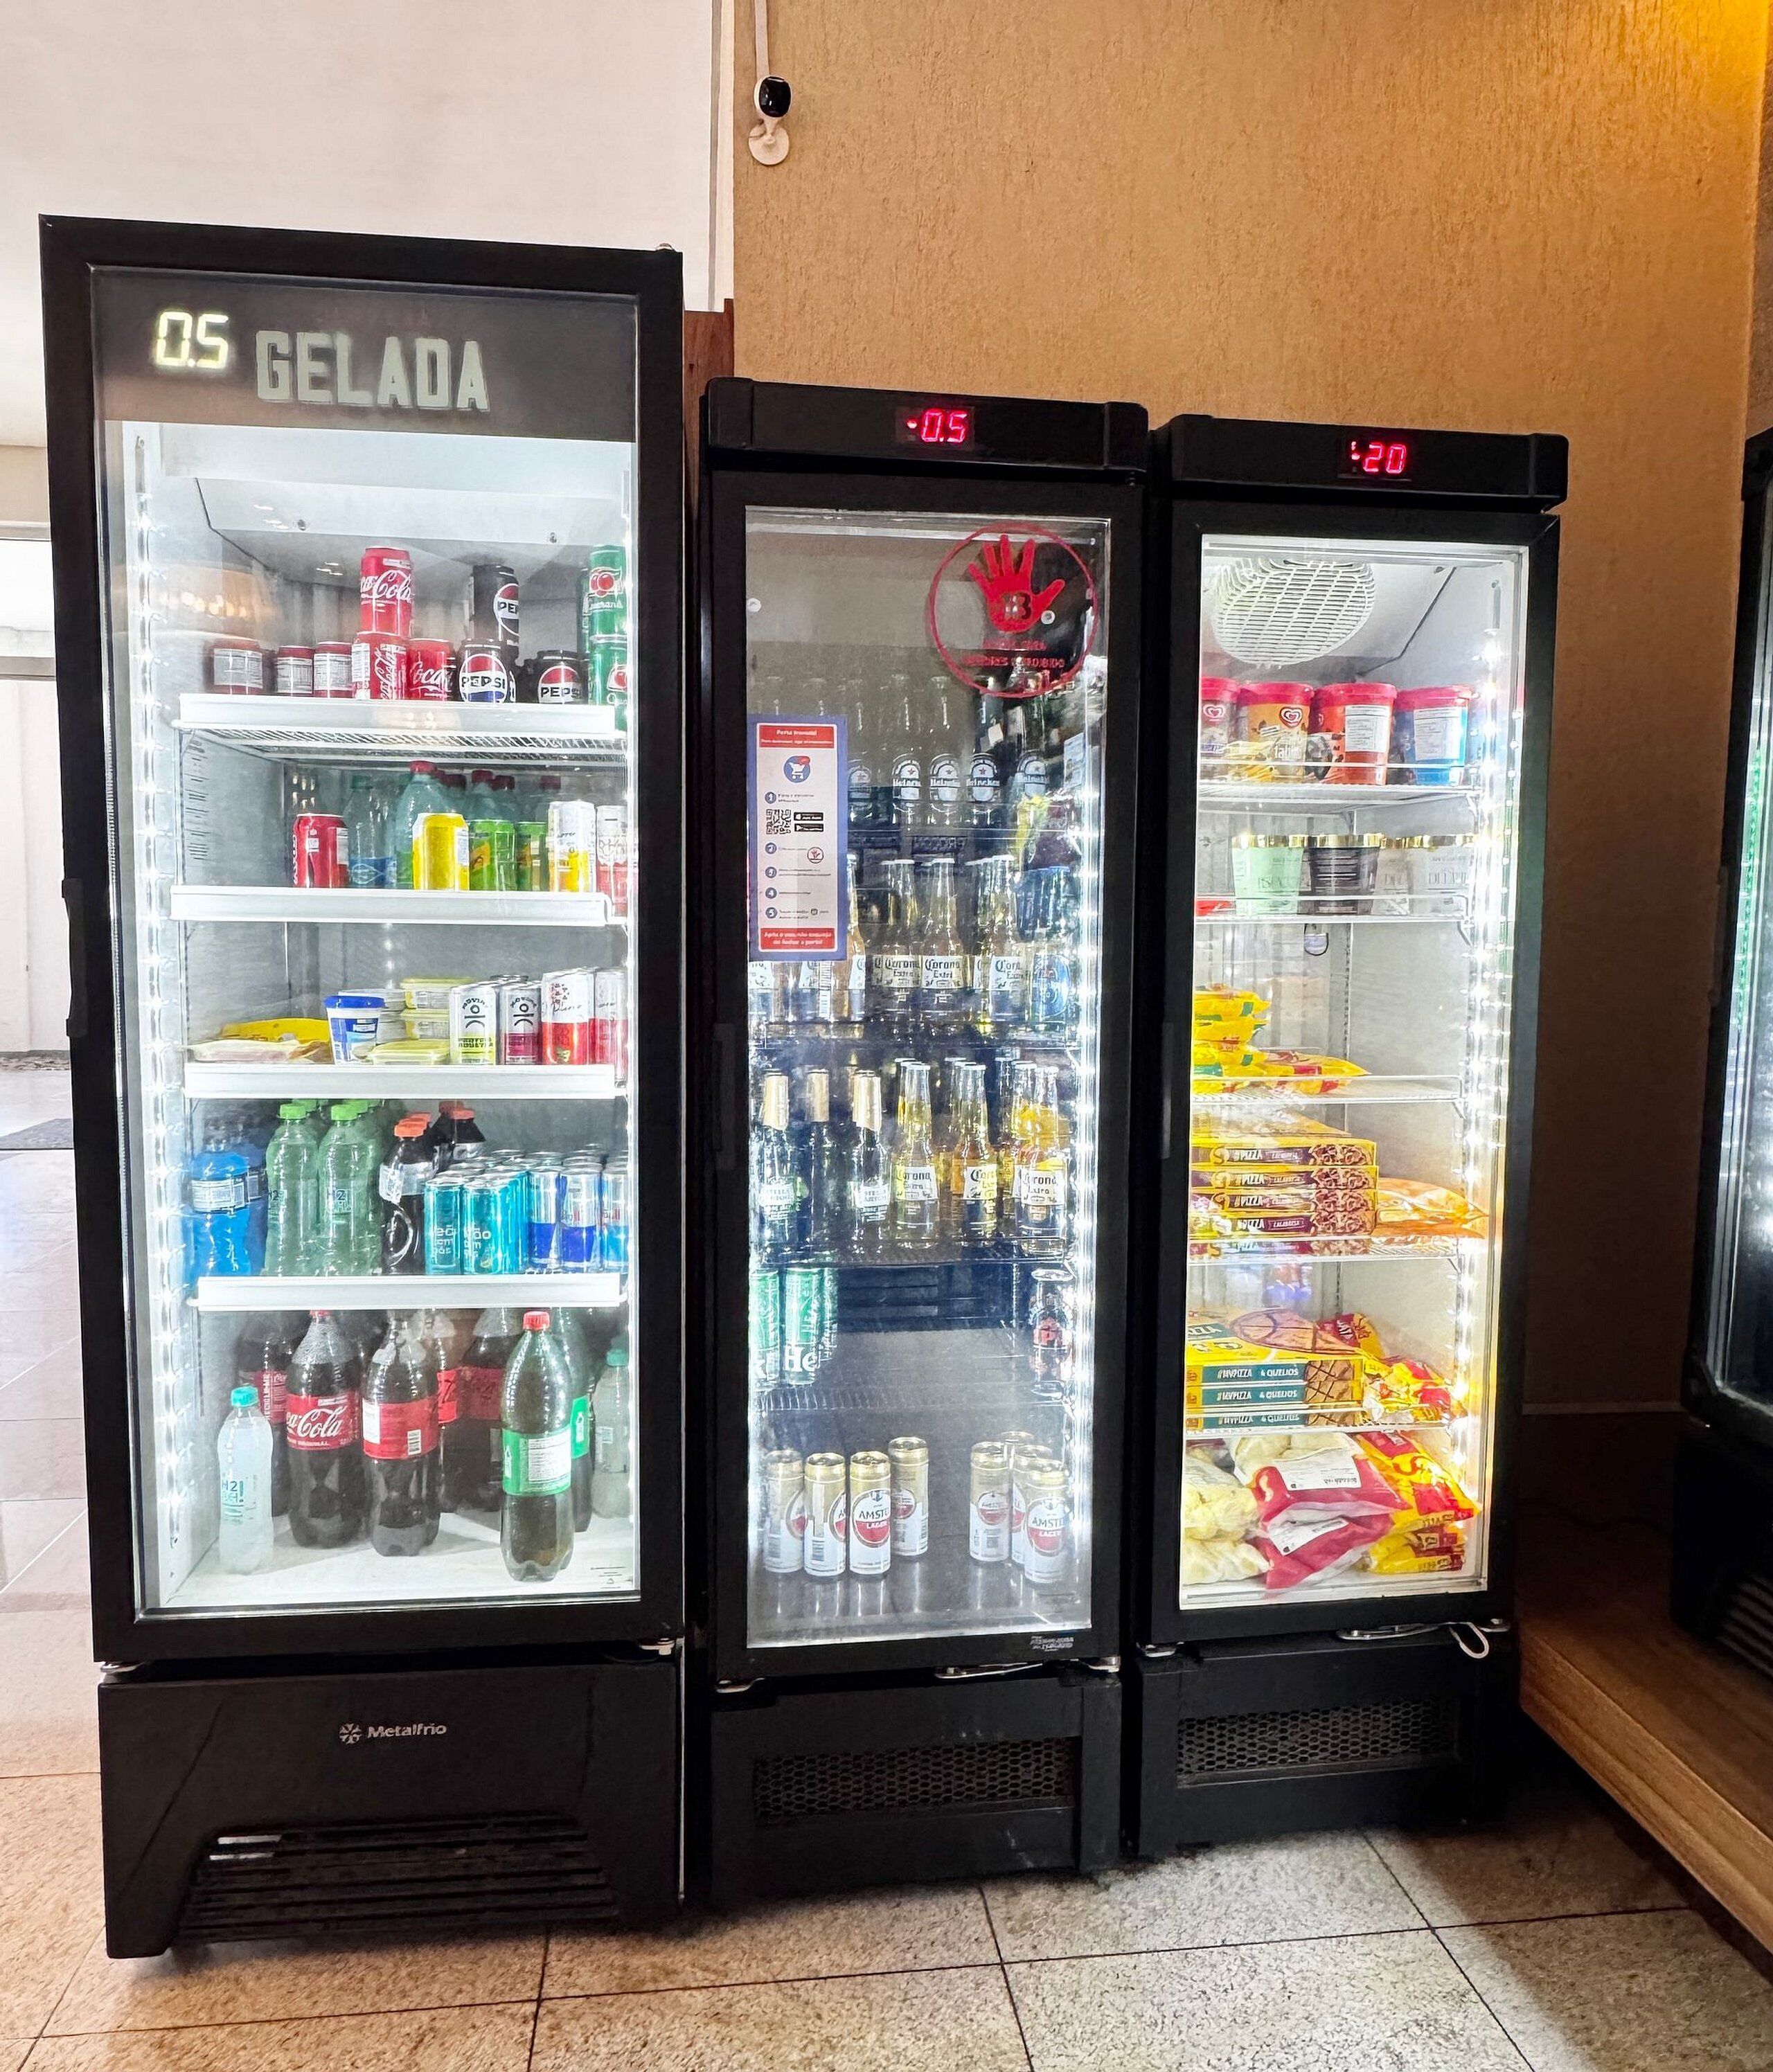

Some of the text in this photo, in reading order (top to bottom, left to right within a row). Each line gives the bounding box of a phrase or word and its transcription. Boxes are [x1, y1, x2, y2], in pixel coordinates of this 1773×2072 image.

[255, 329, 490, 411] GELADA
[461, 675, 506, 689] PEPSI
[368, 1723, 447, 1739] Metalfrio
